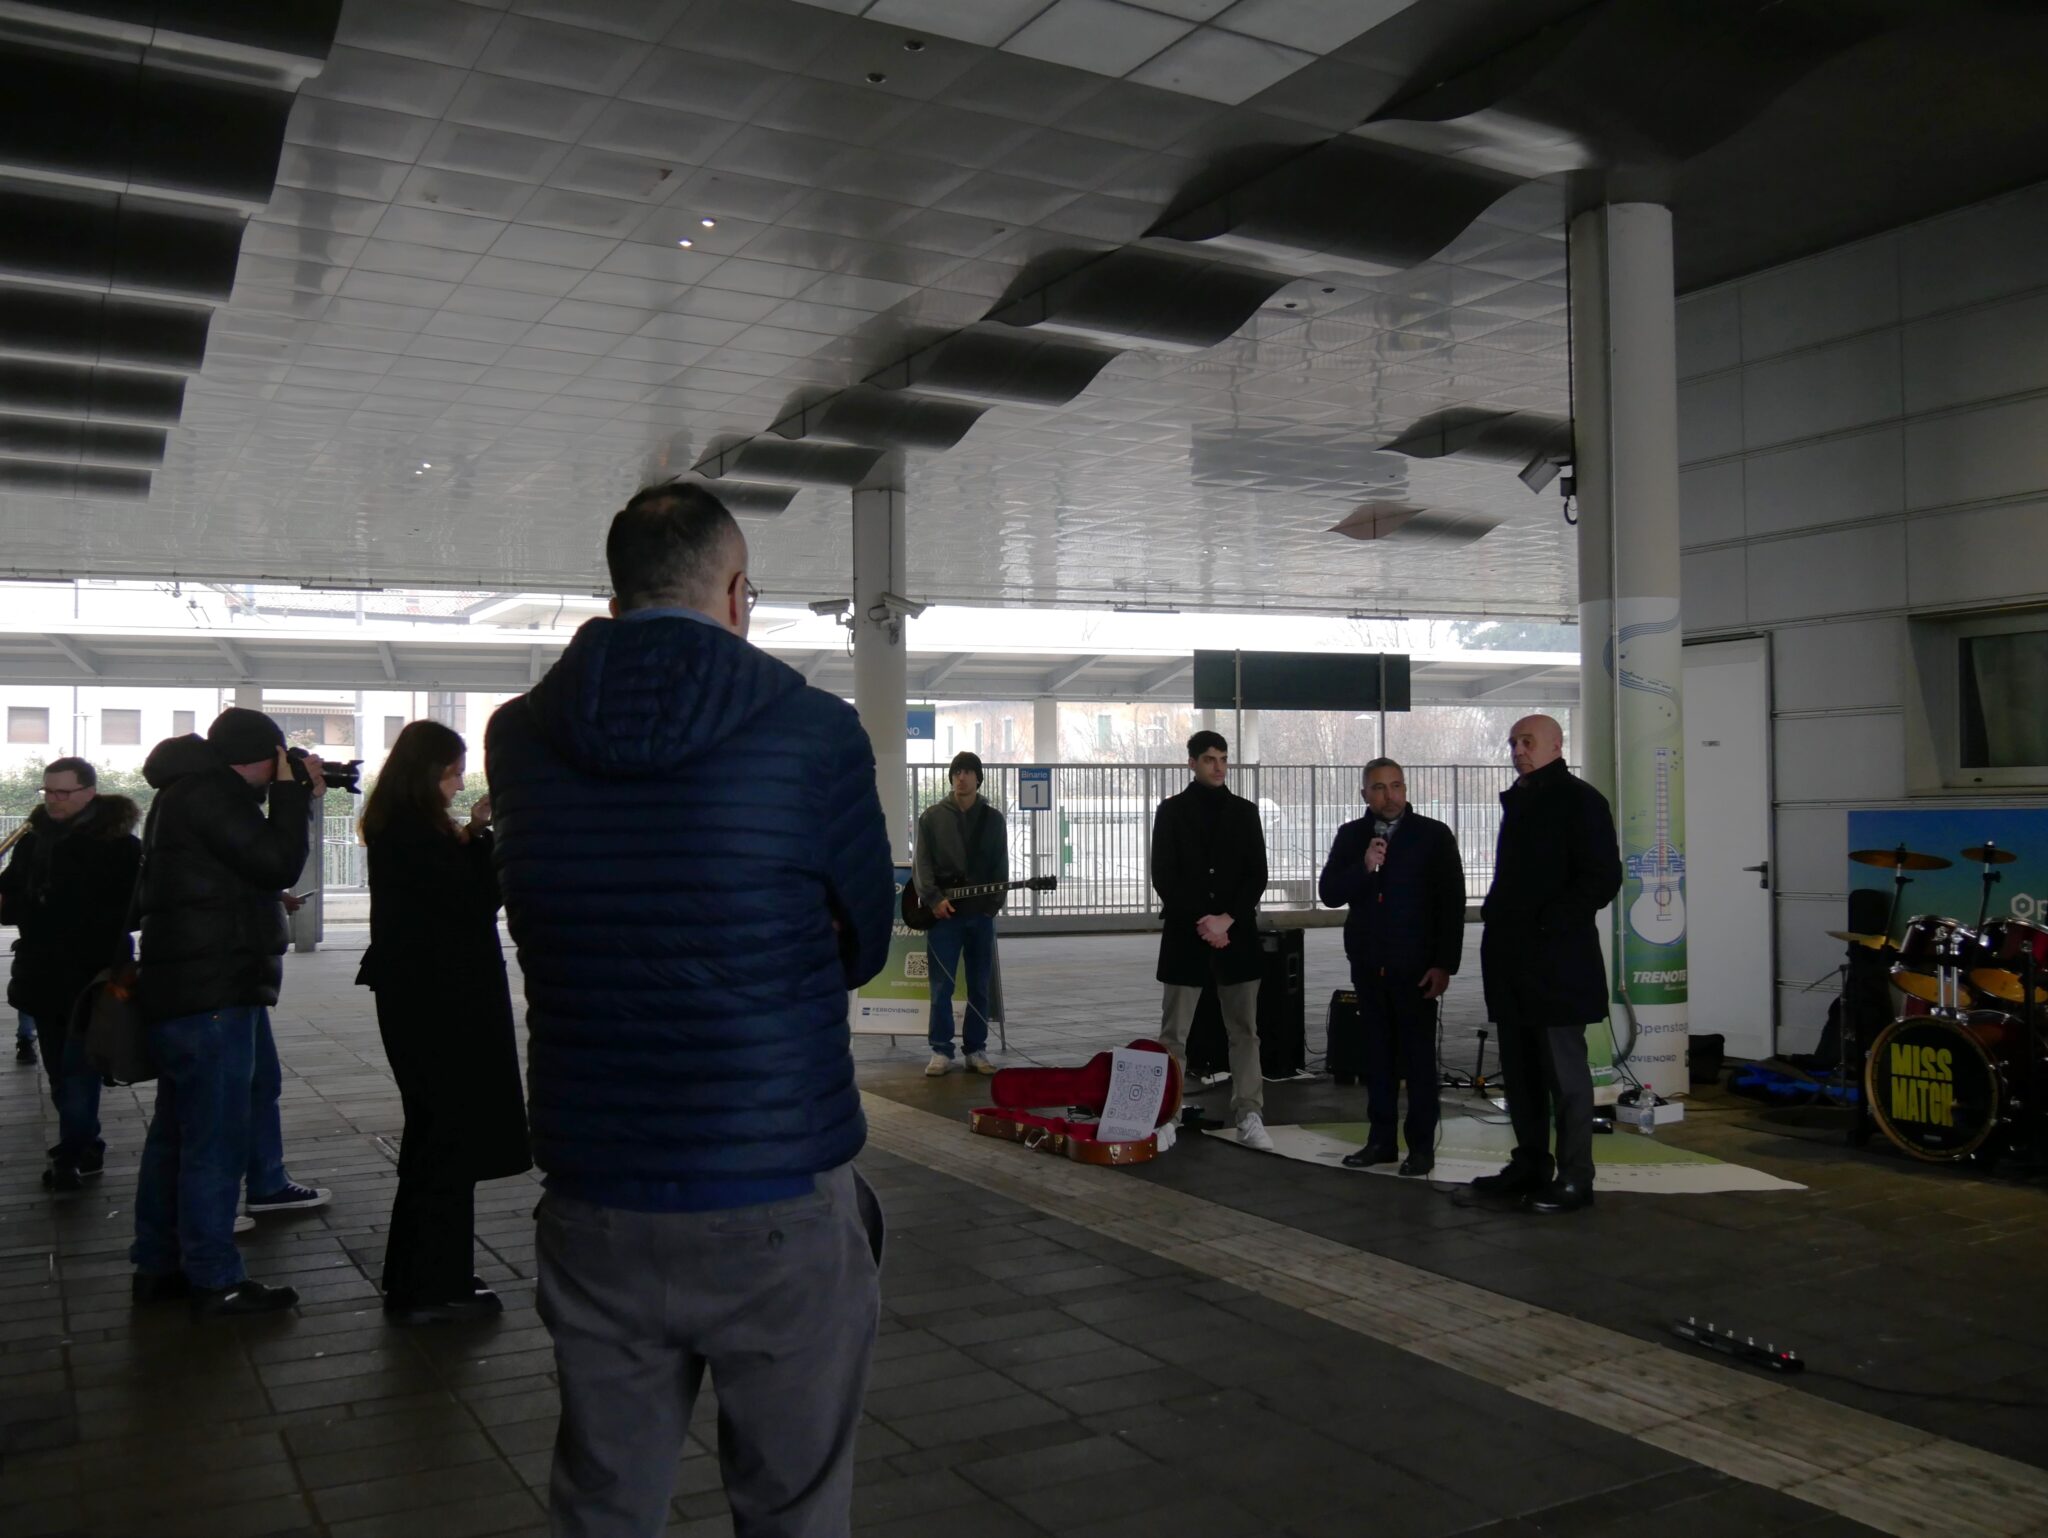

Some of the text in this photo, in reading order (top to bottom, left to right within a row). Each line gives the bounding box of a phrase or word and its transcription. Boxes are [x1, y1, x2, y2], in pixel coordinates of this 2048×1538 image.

[1021, 770, 1048, 779] Binario
[1030, 783, 1039, 804] 1
[1628, 1054, 1677, 1062] OVIENORD
[1890, 1043, 1953, 1081] MISS
[1890, 1076, 1954, 1127] MATCH
